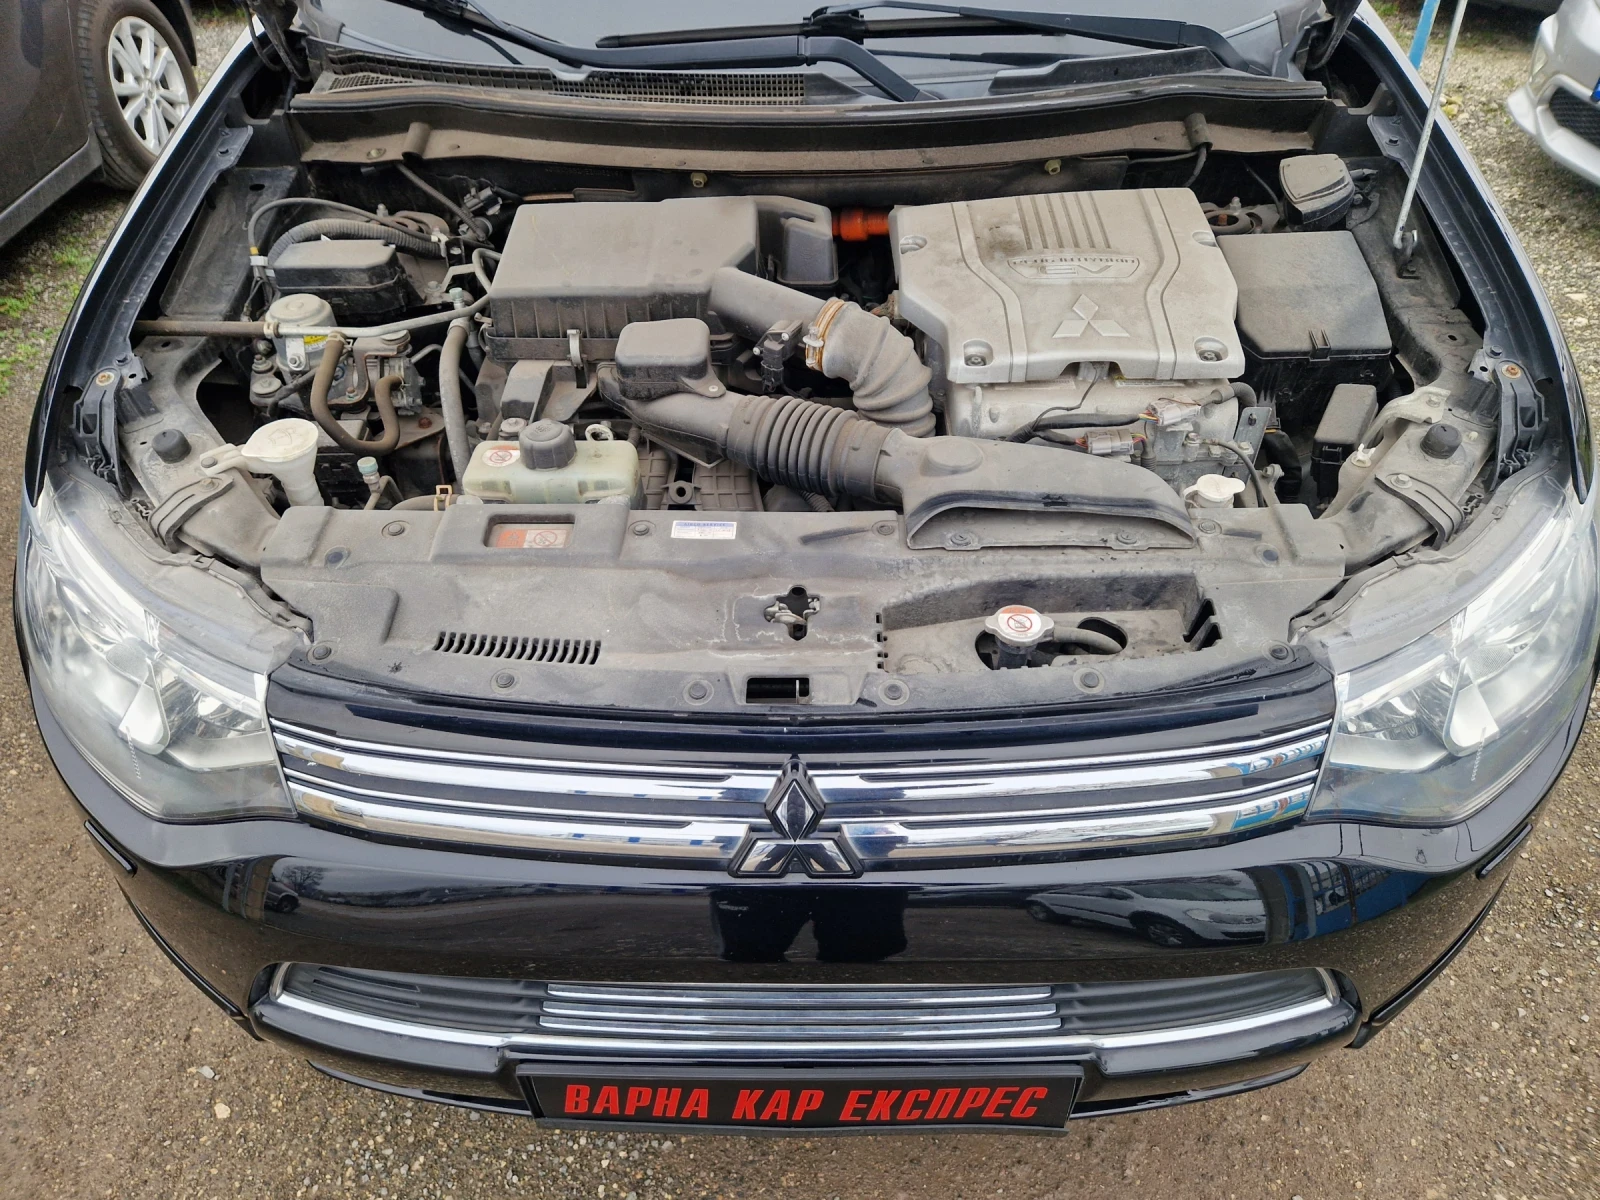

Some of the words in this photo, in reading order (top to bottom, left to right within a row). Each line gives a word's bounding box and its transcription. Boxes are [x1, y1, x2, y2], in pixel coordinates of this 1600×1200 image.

[564, 1084, 709, 1119] ВАРНА
[731, 1089, 825, 1121] КАР
[838, 1086, 1049, 1121] ЕКСПРЕС
